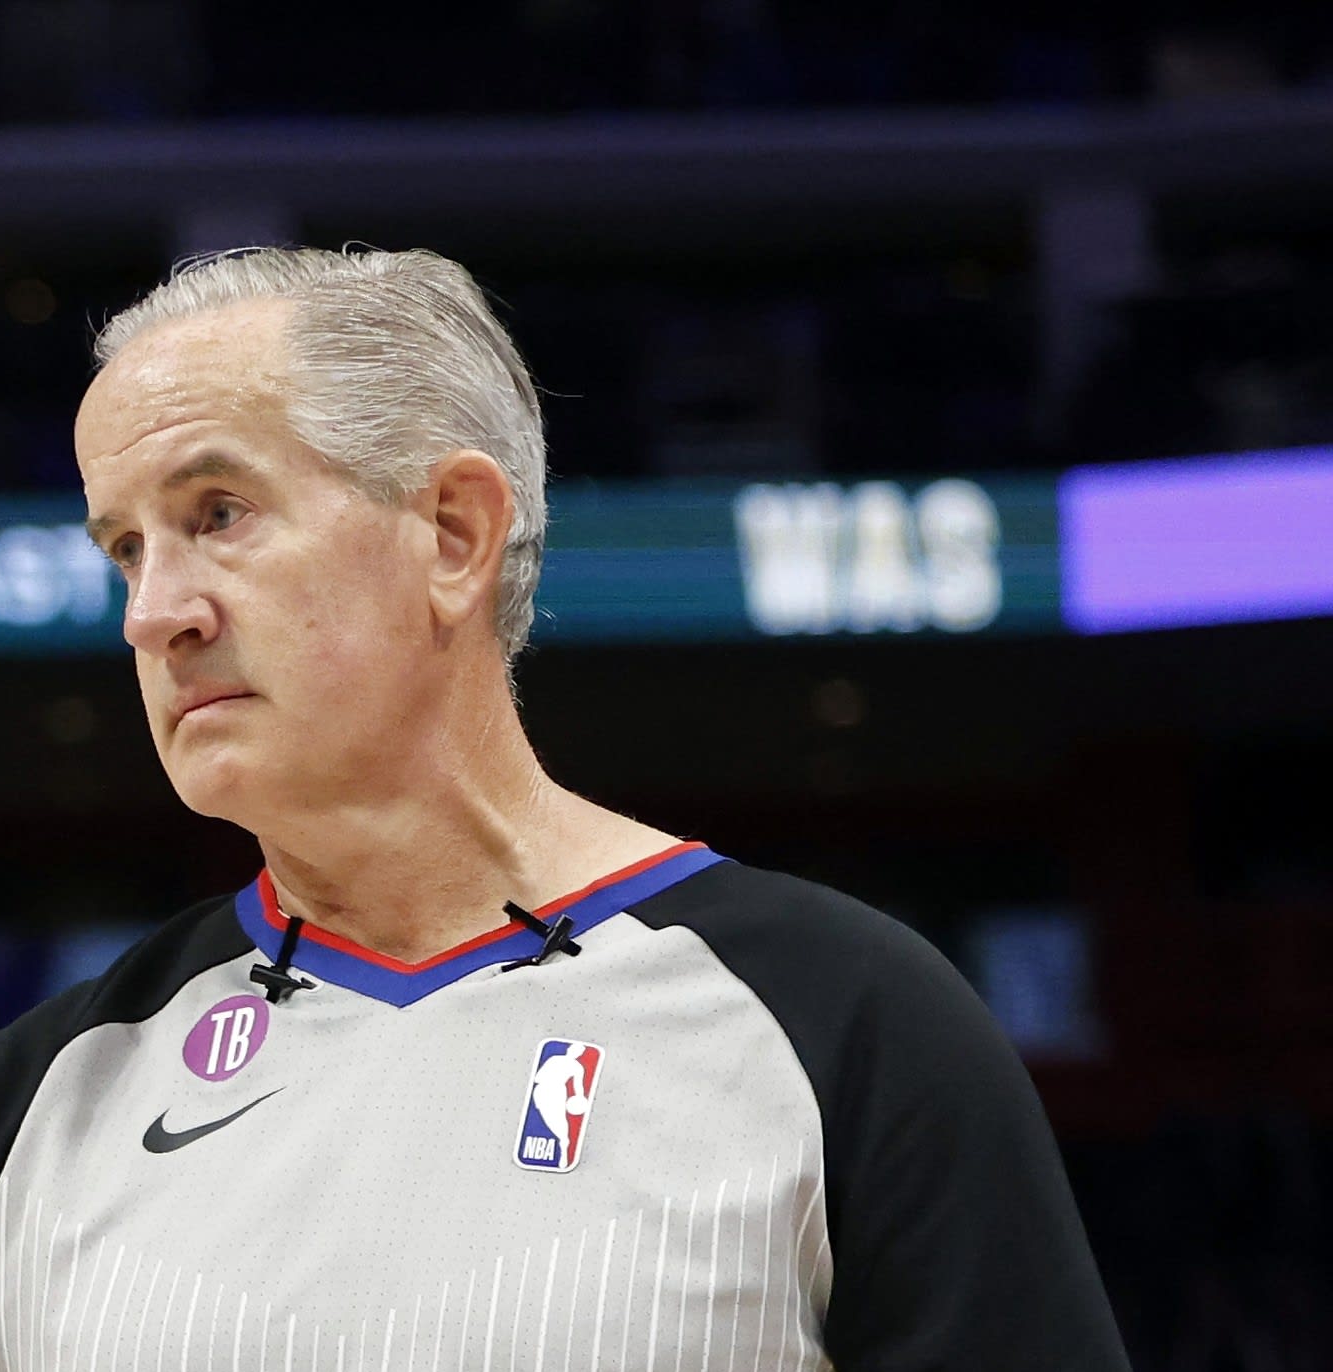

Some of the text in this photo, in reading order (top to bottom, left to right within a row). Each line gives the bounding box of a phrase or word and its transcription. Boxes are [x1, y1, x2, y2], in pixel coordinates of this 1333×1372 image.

[735, 481, 1002, 634] WAS
[206, 1006, 255, 1075] TB
[522, 1135, 556, 1161] NBA
